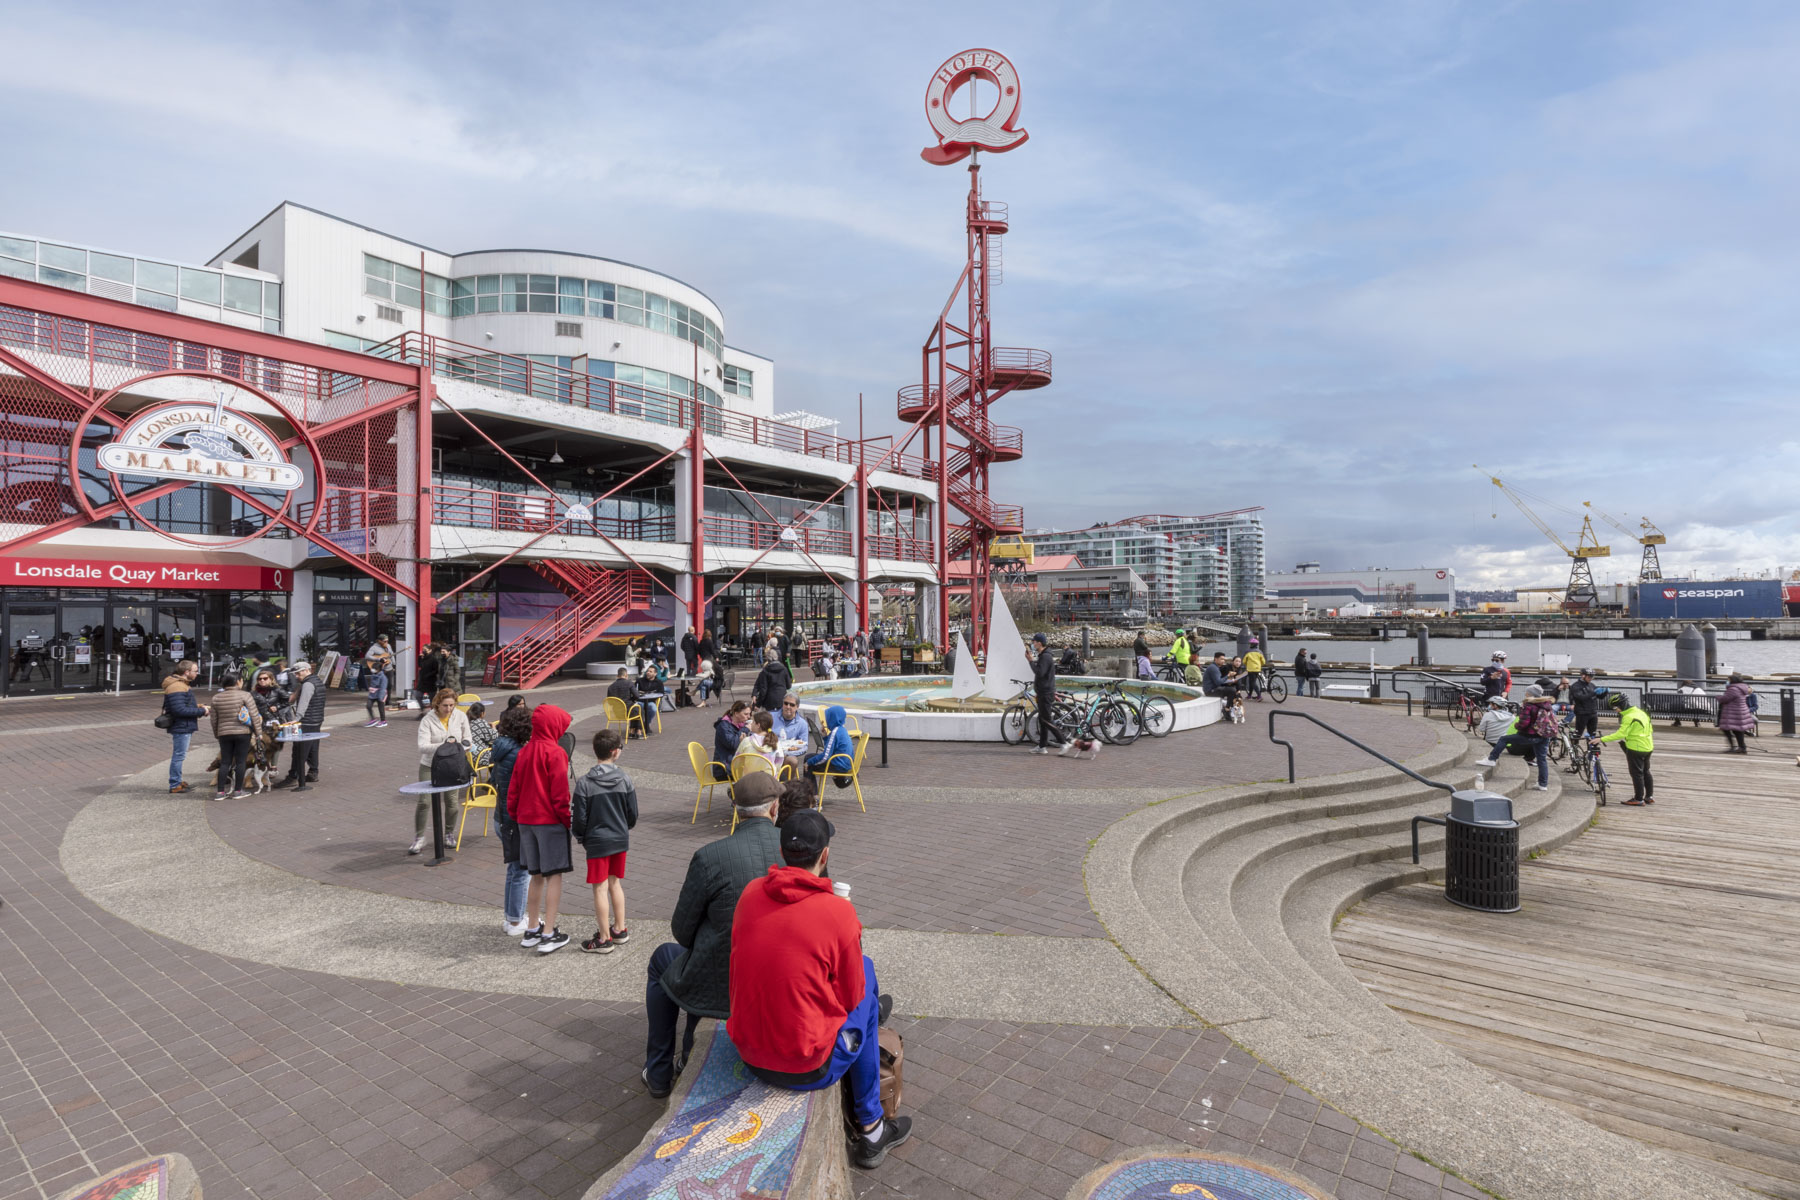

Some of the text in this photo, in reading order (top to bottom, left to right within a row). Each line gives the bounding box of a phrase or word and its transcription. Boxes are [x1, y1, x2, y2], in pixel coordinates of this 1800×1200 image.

[938, 52, 1006, 86] HOTEL
[138, 411, 274, 462] LONSDALE QUAY
[127, 451, 281, 482] MARKET
[15, 562, 220, 583] Lonsdale Quay Market
[273, 569, 283, 589] Q
[1678, 589, 1744, 598] seaspan
